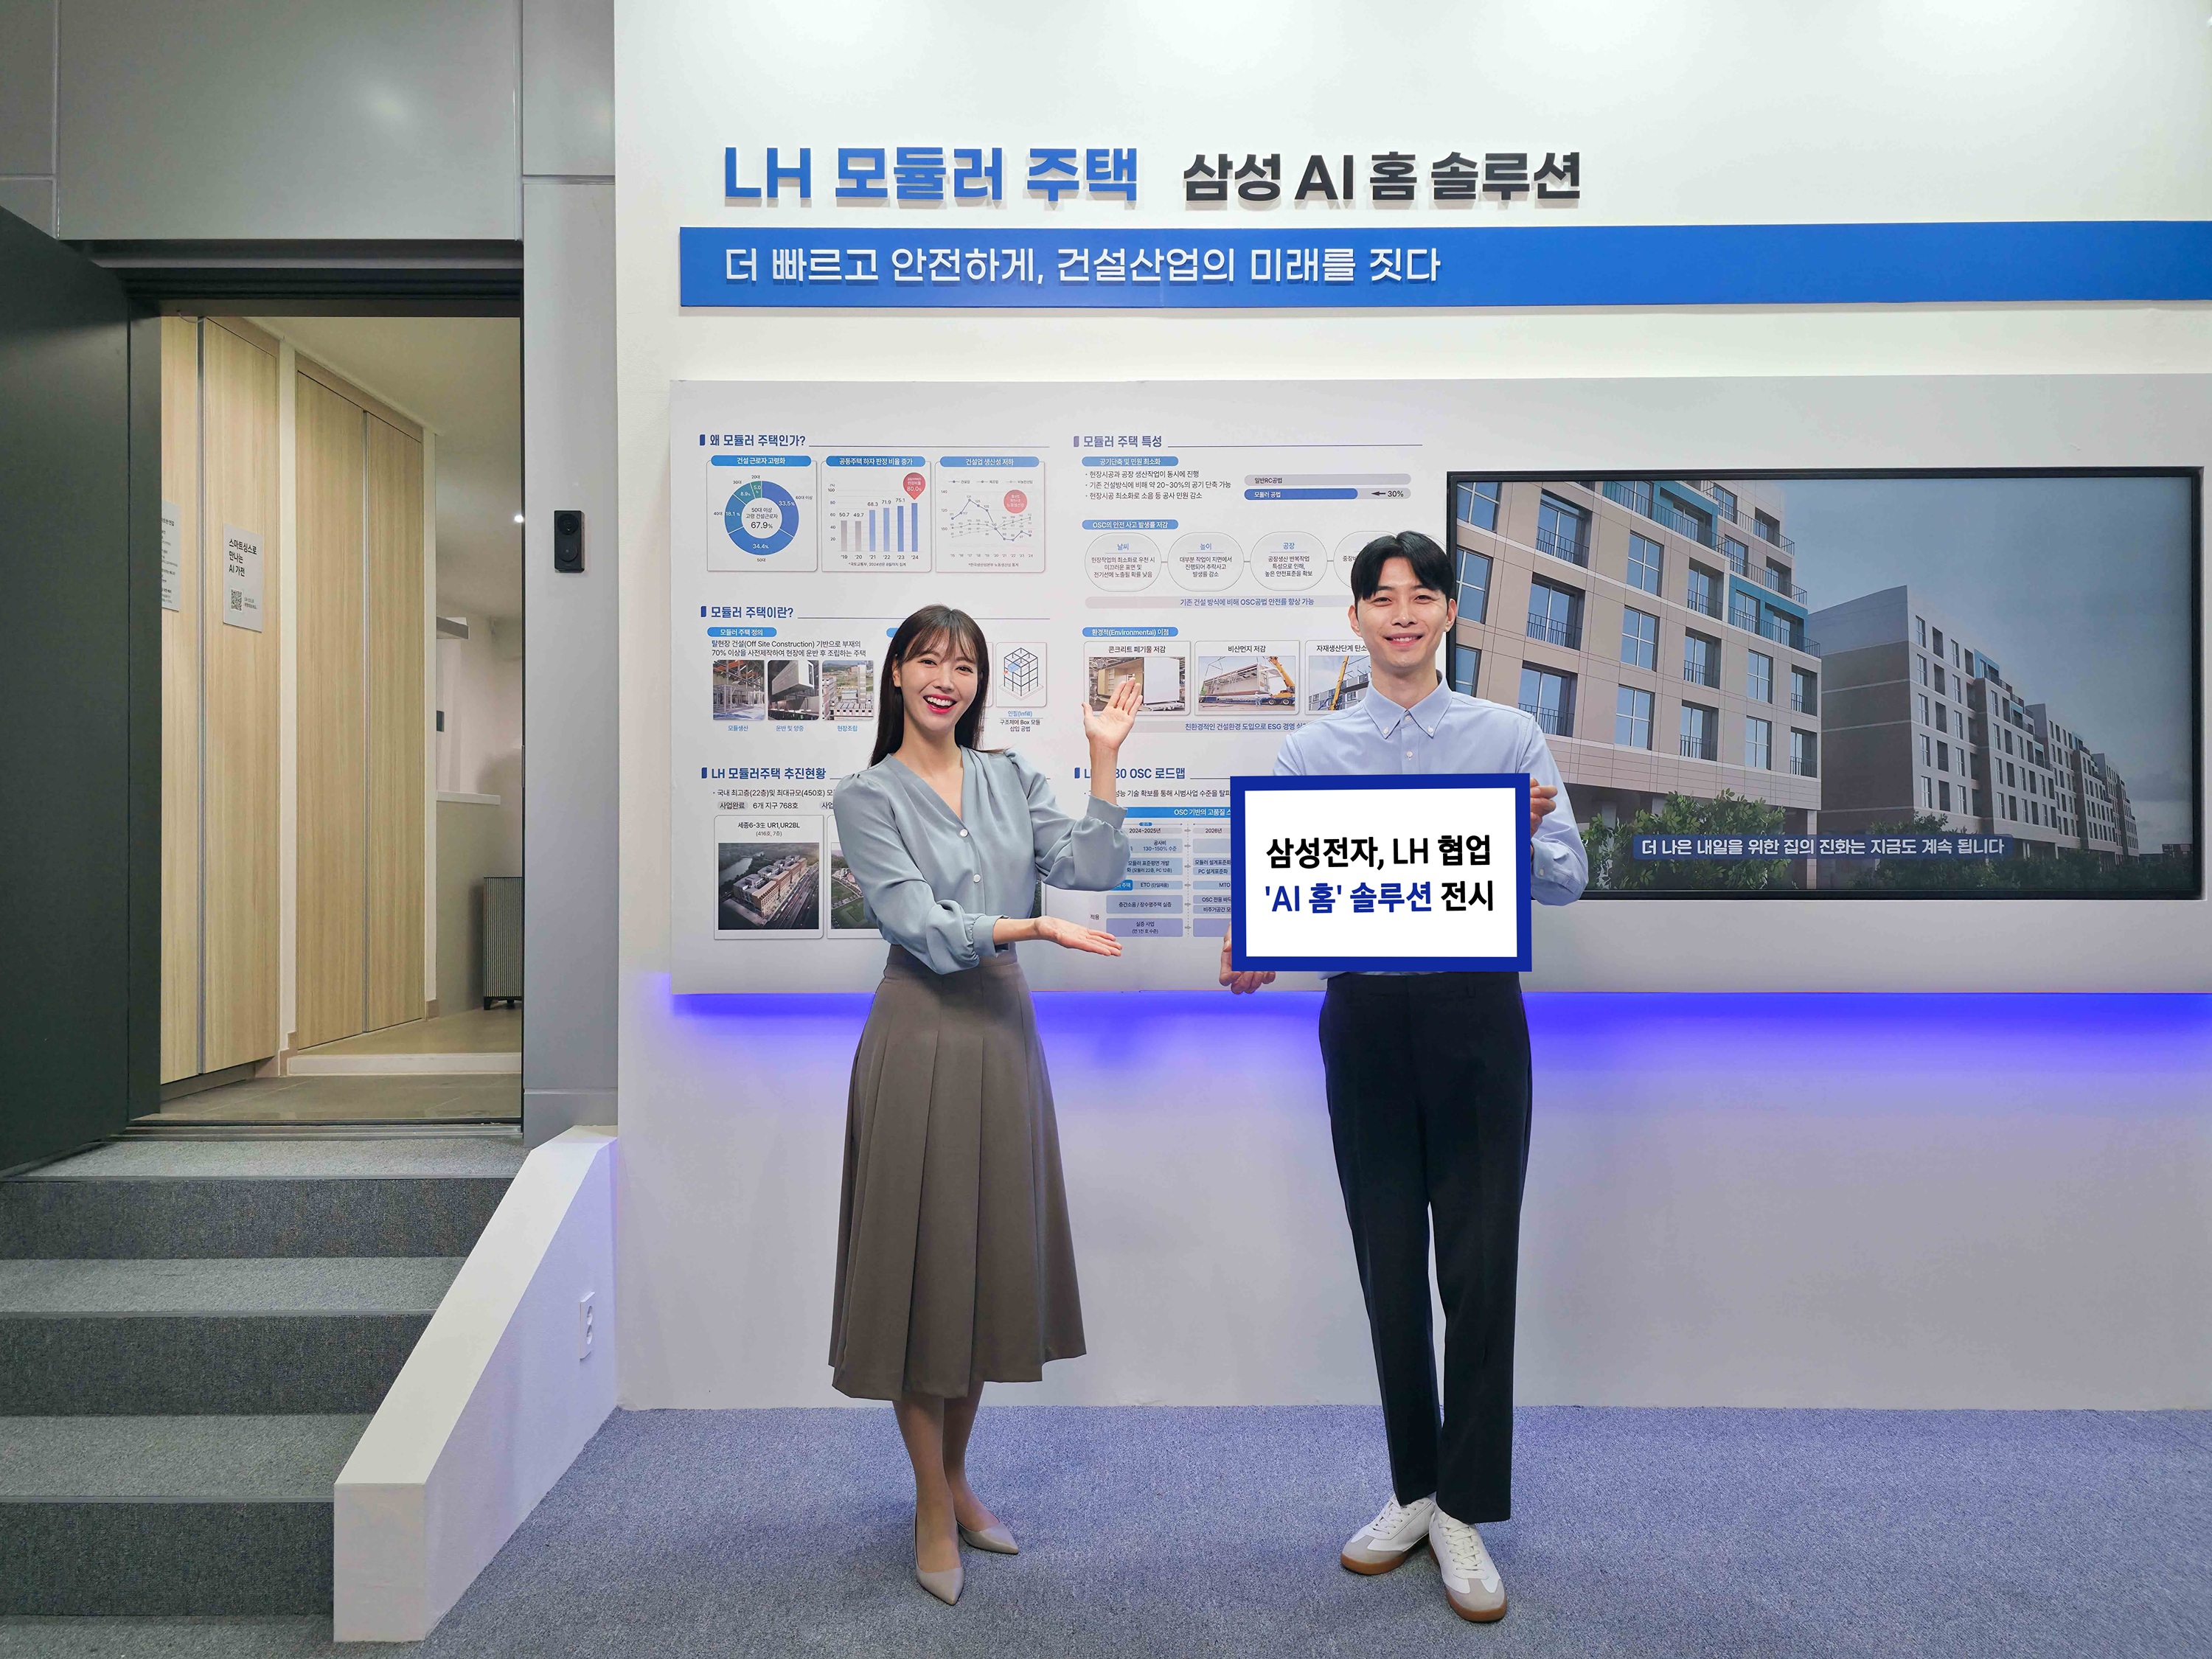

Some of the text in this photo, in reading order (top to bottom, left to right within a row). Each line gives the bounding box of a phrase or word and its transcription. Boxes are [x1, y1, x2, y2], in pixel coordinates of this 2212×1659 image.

[725, 146, 1137, 201] LH 모듈러 주택
[1184, 151, 1580, 201] 삼성 AI 홈 솔루션
[726, 248, 1441, 286] 더 빠르고 안전하게, 건설산업의 미래를 짓다
[710, 434, 805, 446] 왜 모듈러 주택인가?
[1084, 436, 1162, 447] 모듈러 주택 특성
[229, 538, 257, 554] 스마트싱스로
[229, 552, 243, 563] 만나는
[229, 564, 245, 577] AI 가전
[712, 607, 793, 618] 모듈러 주택이란?
[712, 768, 826, 779] LH 모듈러주택 추진현황
[1130, 768, 1185, 779] OSC 로드맵
[1267, 835, 1490, 870] 삼성전자, LH 협업
[1642, 840, 2004, 855] 더 나은 내일을 위한 집의 진화는 지금도 계속 됩니다
[1265, 880, 1492, 914] 'AI 홈' 솔루션 전시
